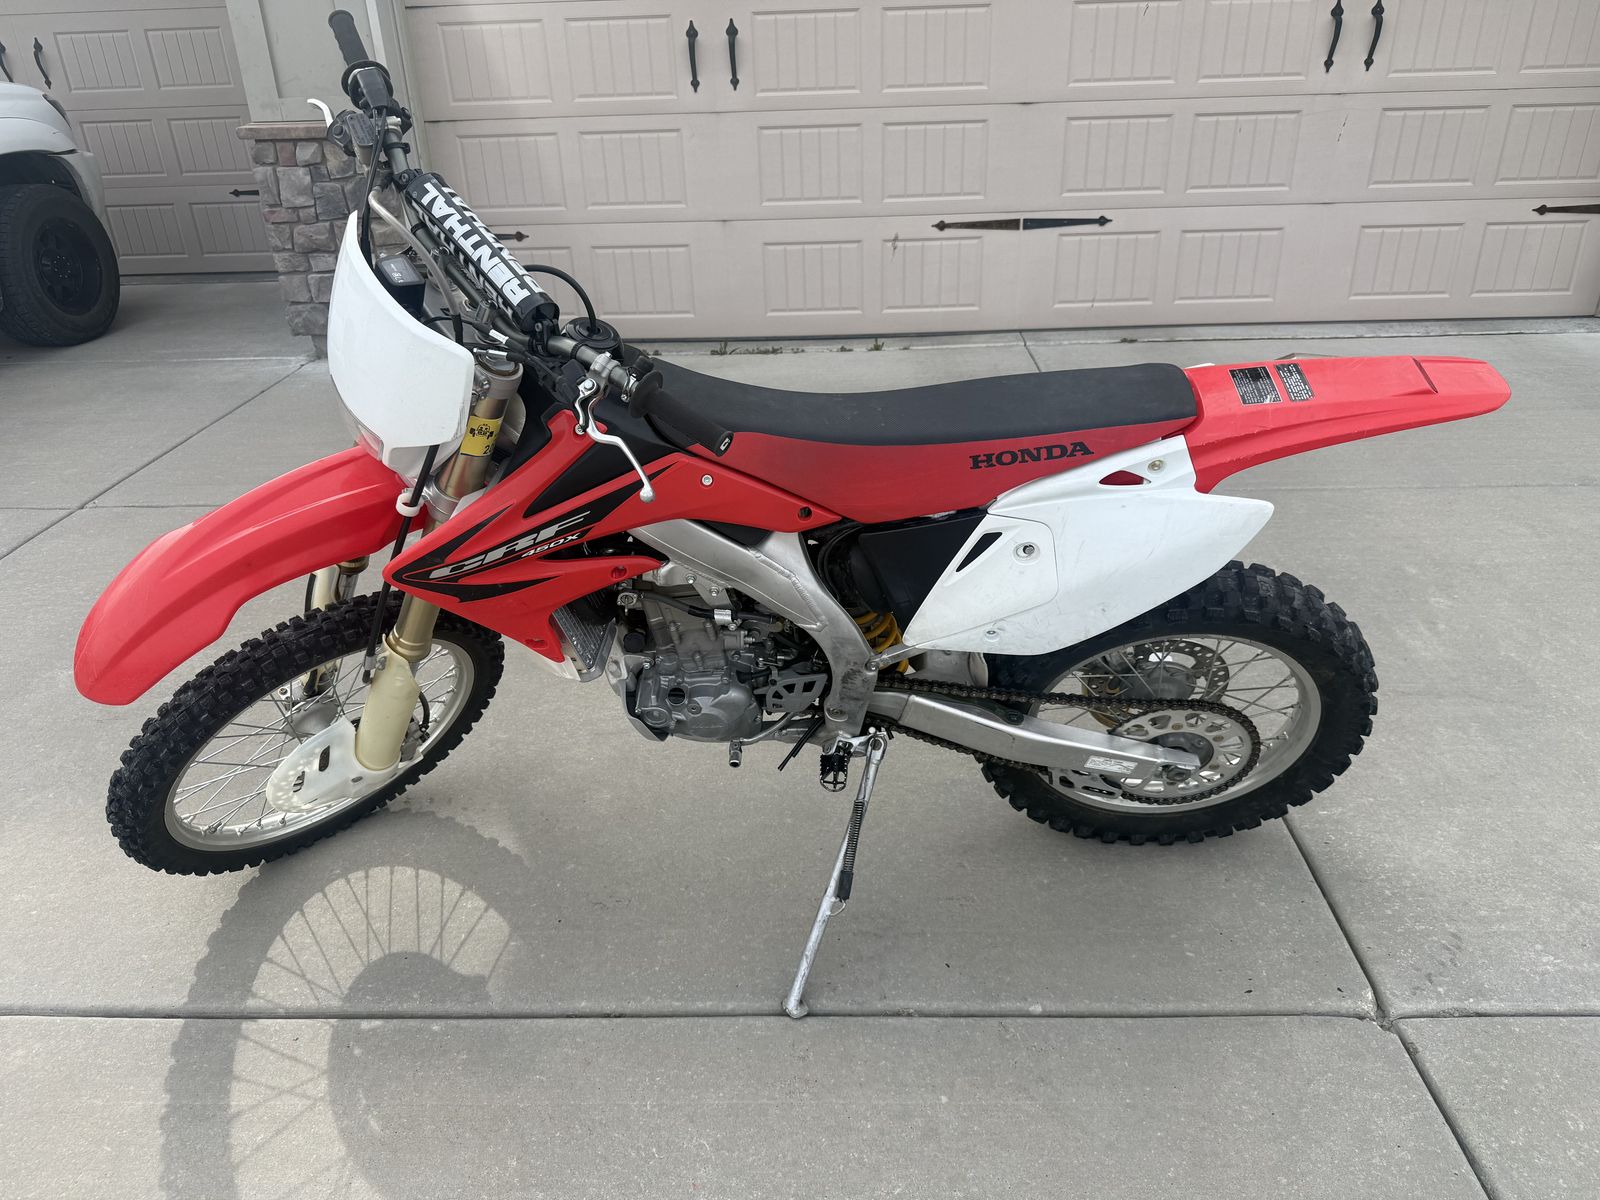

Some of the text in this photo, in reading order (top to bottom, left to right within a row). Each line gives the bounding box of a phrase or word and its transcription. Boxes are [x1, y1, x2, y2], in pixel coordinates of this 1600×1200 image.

[421, 182, 531, 306] RENTHAL
[969, 441, 1095, 470] HONDA
[429, 510, 591, 579] CRF
[520, 532, 581, 558] 450X
